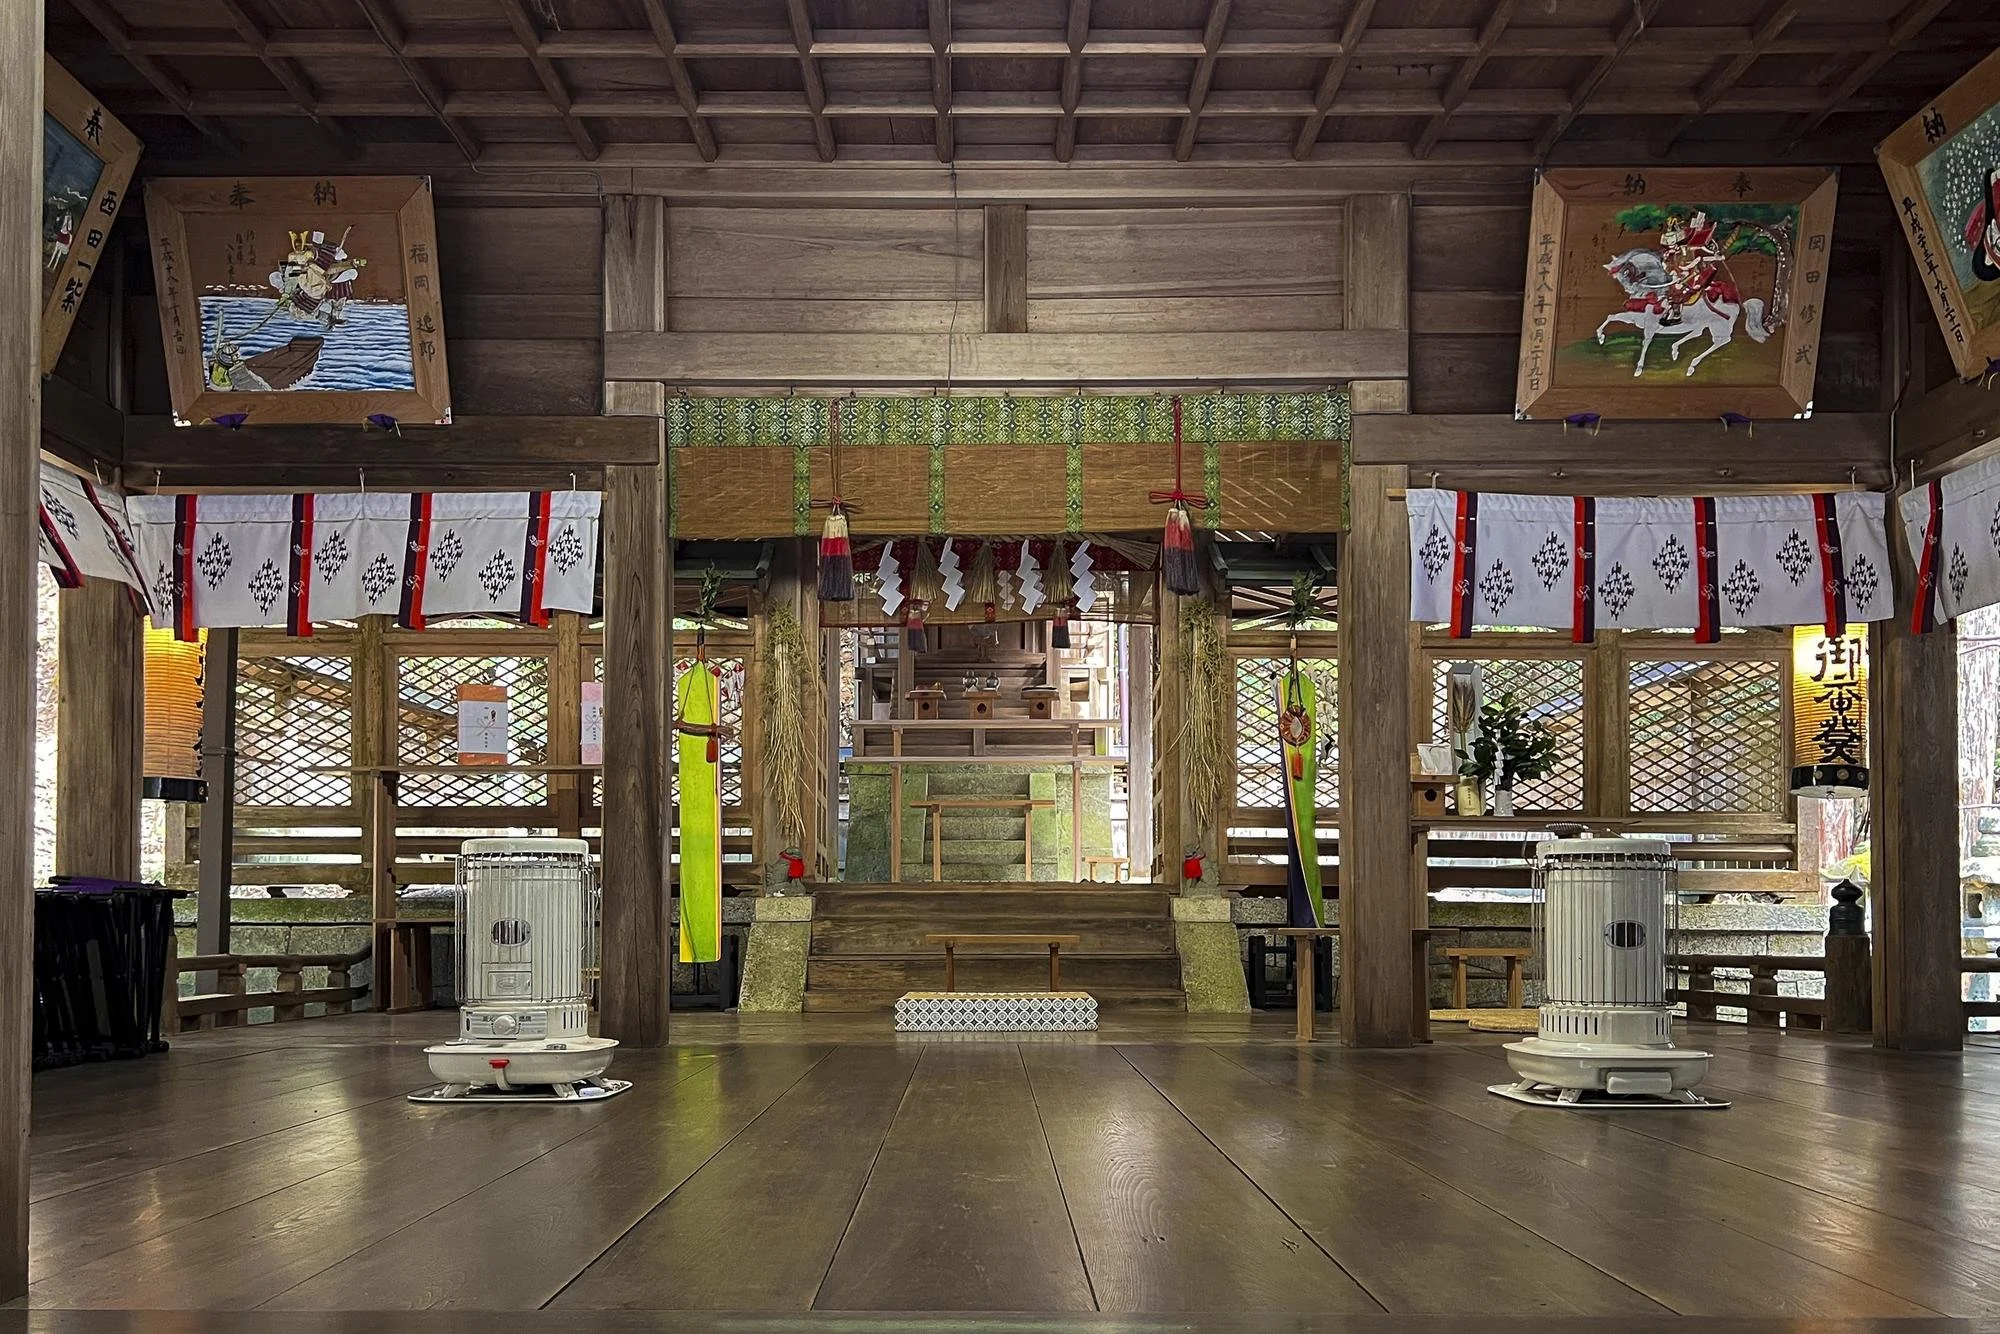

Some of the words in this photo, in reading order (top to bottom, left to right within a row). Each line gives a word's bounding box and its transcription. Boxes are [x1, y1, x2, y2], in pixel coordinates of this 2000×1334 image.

[1527, 234, 1557, 391] 平成十八年四月二十九日
